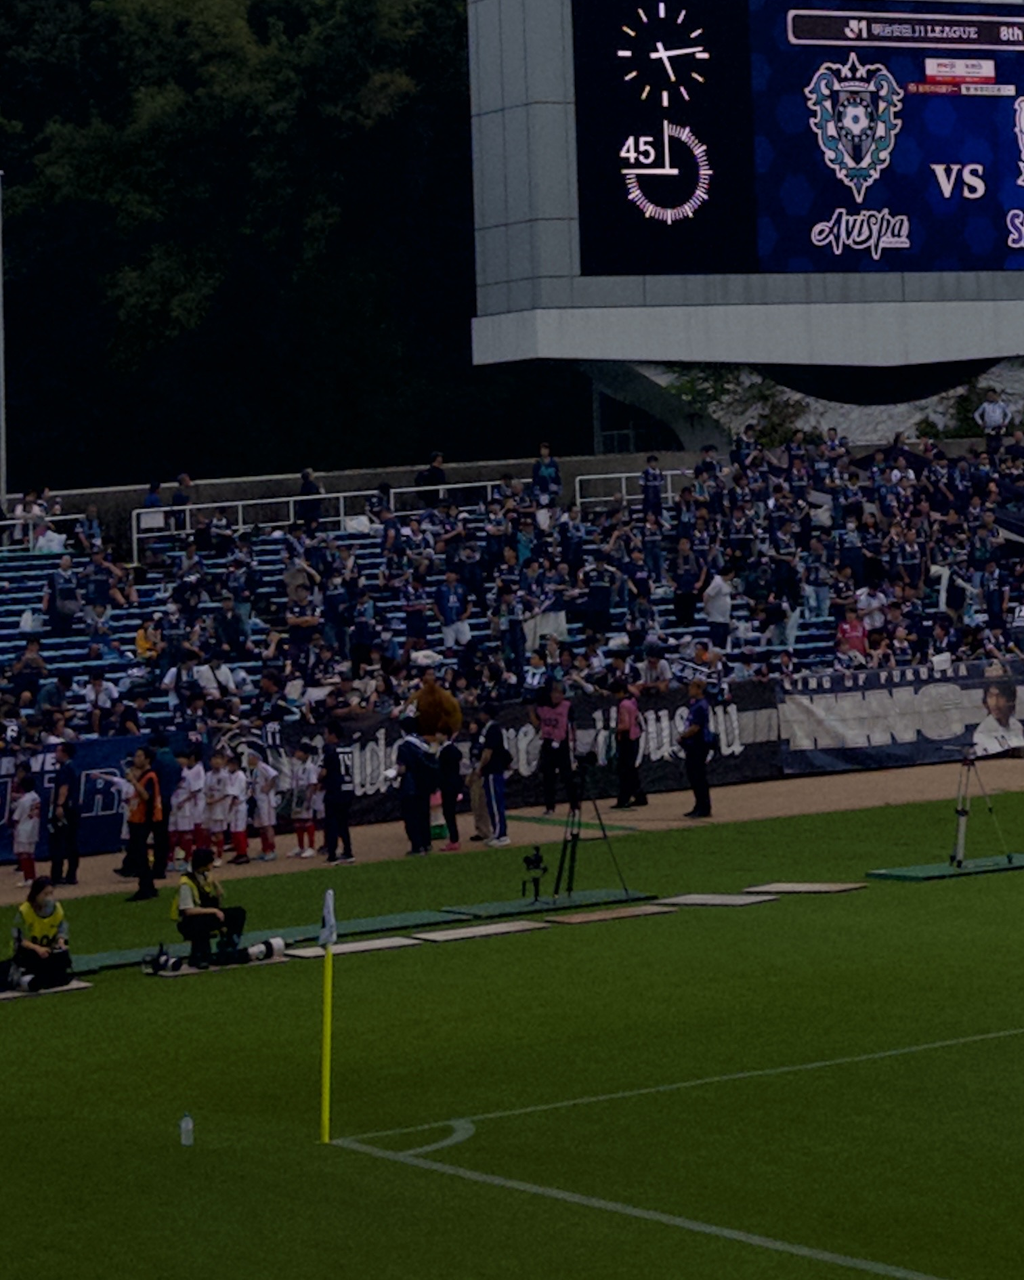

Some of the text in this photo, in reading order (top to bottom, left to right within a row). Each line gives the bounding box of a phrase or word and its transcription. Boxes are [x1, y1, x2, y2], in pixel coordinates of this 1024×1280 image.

[927, 25, 978, 39] LEAGUE
[999, 26, 1023, 41] 8th
[619, 135, 656, 165] 45
[930, 163, 986, 199] VS
